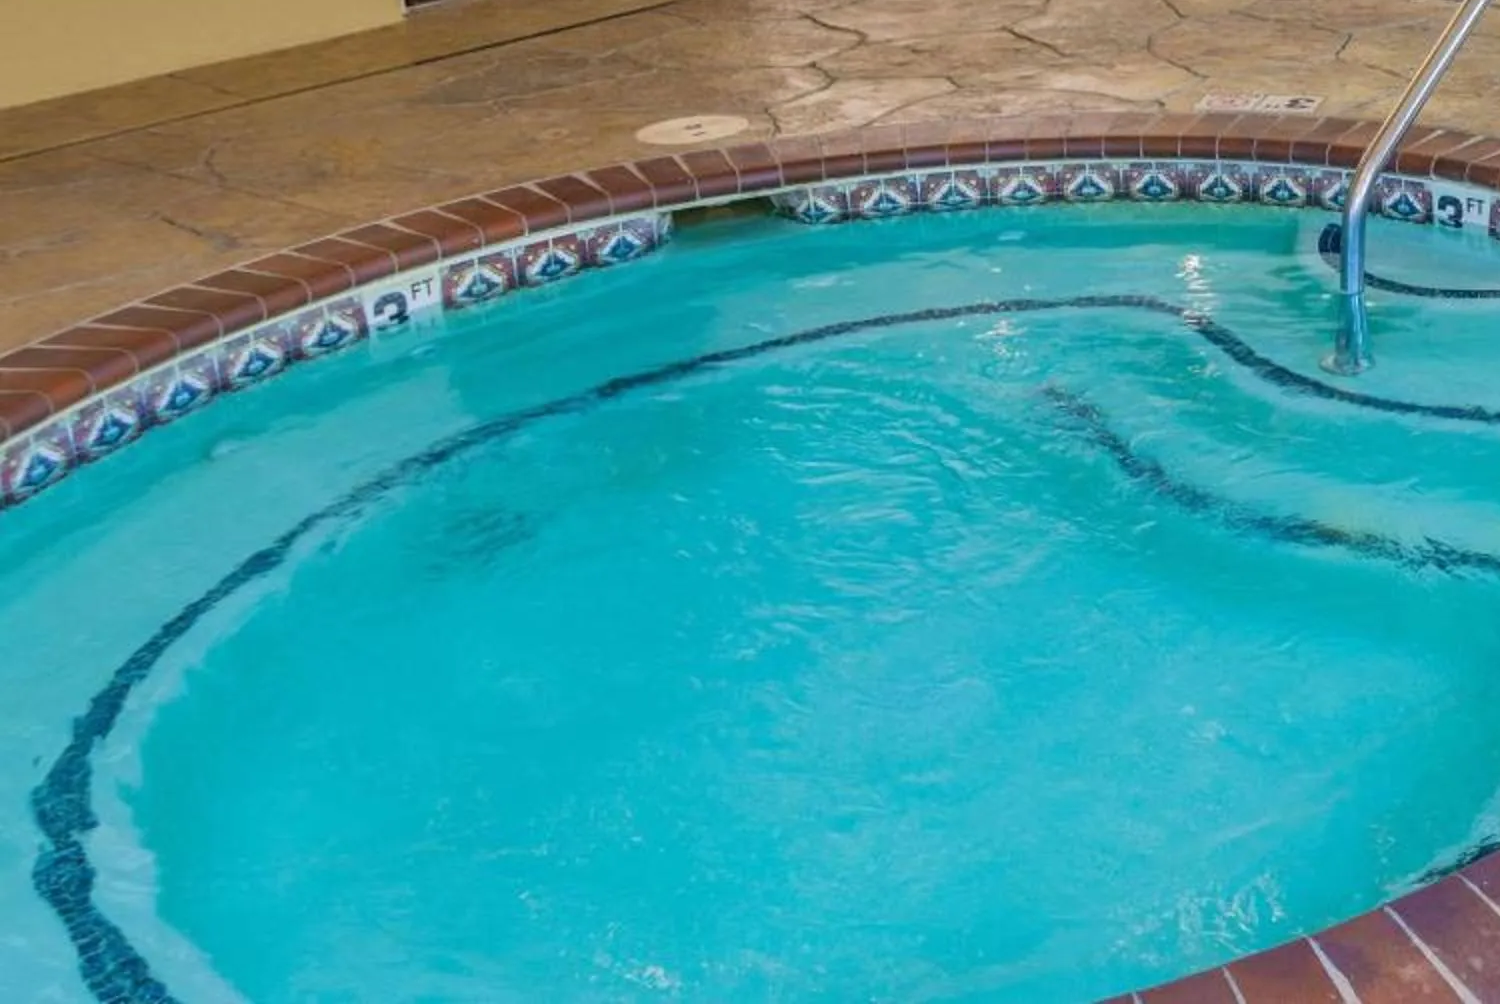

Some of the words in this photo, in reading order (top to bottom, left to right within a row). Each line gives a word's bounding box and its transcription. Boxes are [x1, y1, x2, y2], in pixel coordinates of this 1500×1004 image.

[1437, 195, 1463, 229] 3
[1466, 197, 1486, 215] FT
[373, 291, 411, 330] 3
[410, 277, 434, 301] FT
